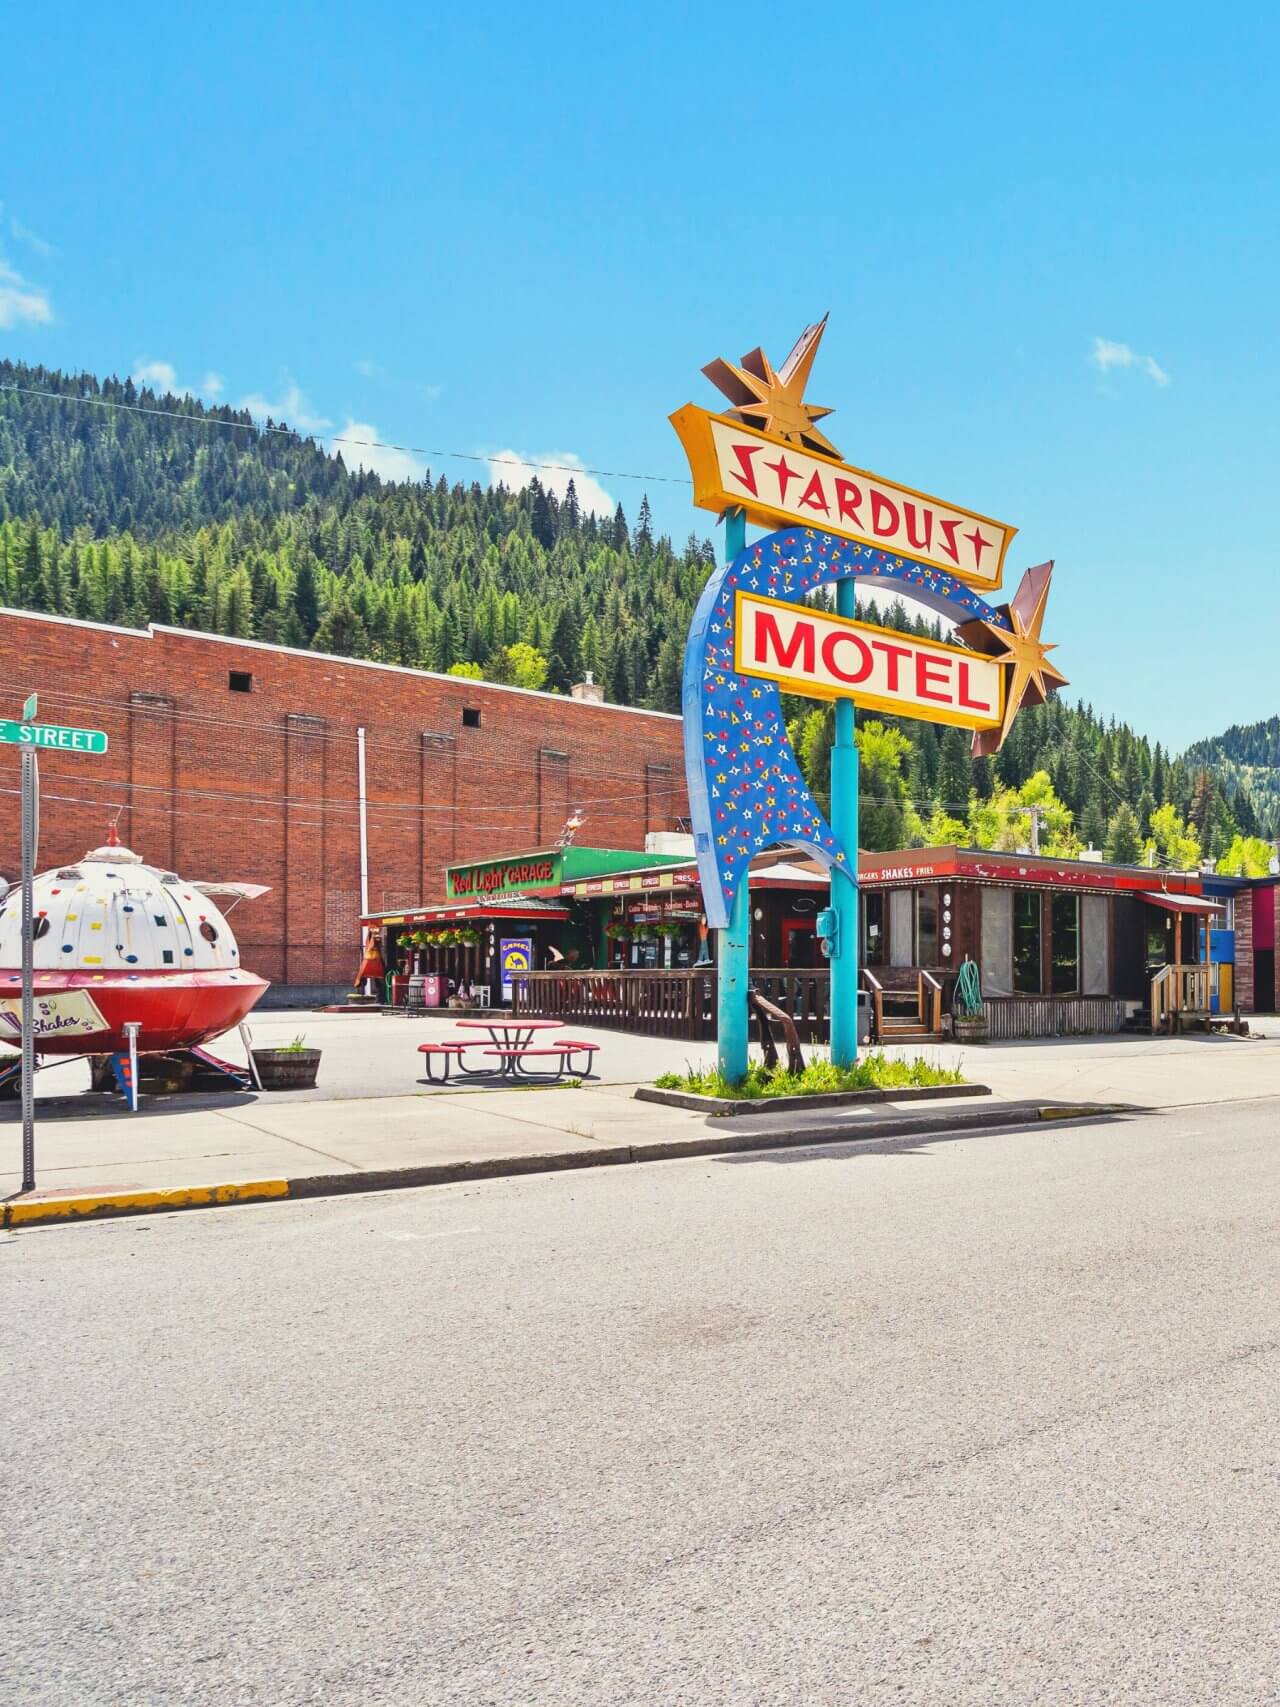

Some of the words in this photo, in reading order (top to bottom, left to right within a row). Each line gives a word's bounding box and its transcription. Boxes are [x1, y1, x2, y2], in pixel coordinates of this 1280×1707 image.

[729, 444, 994, 570] STARDUST
[754, 611, 990, 712] MOTEL
[19, 725, 96, 750] STREET
[881, 867, 913, 879] SHAKES
[916, 866, 934, 875] FRIES
[502, 943, 529, 951] CAMEL
[33, 1015, 80, 1033] Shakes
